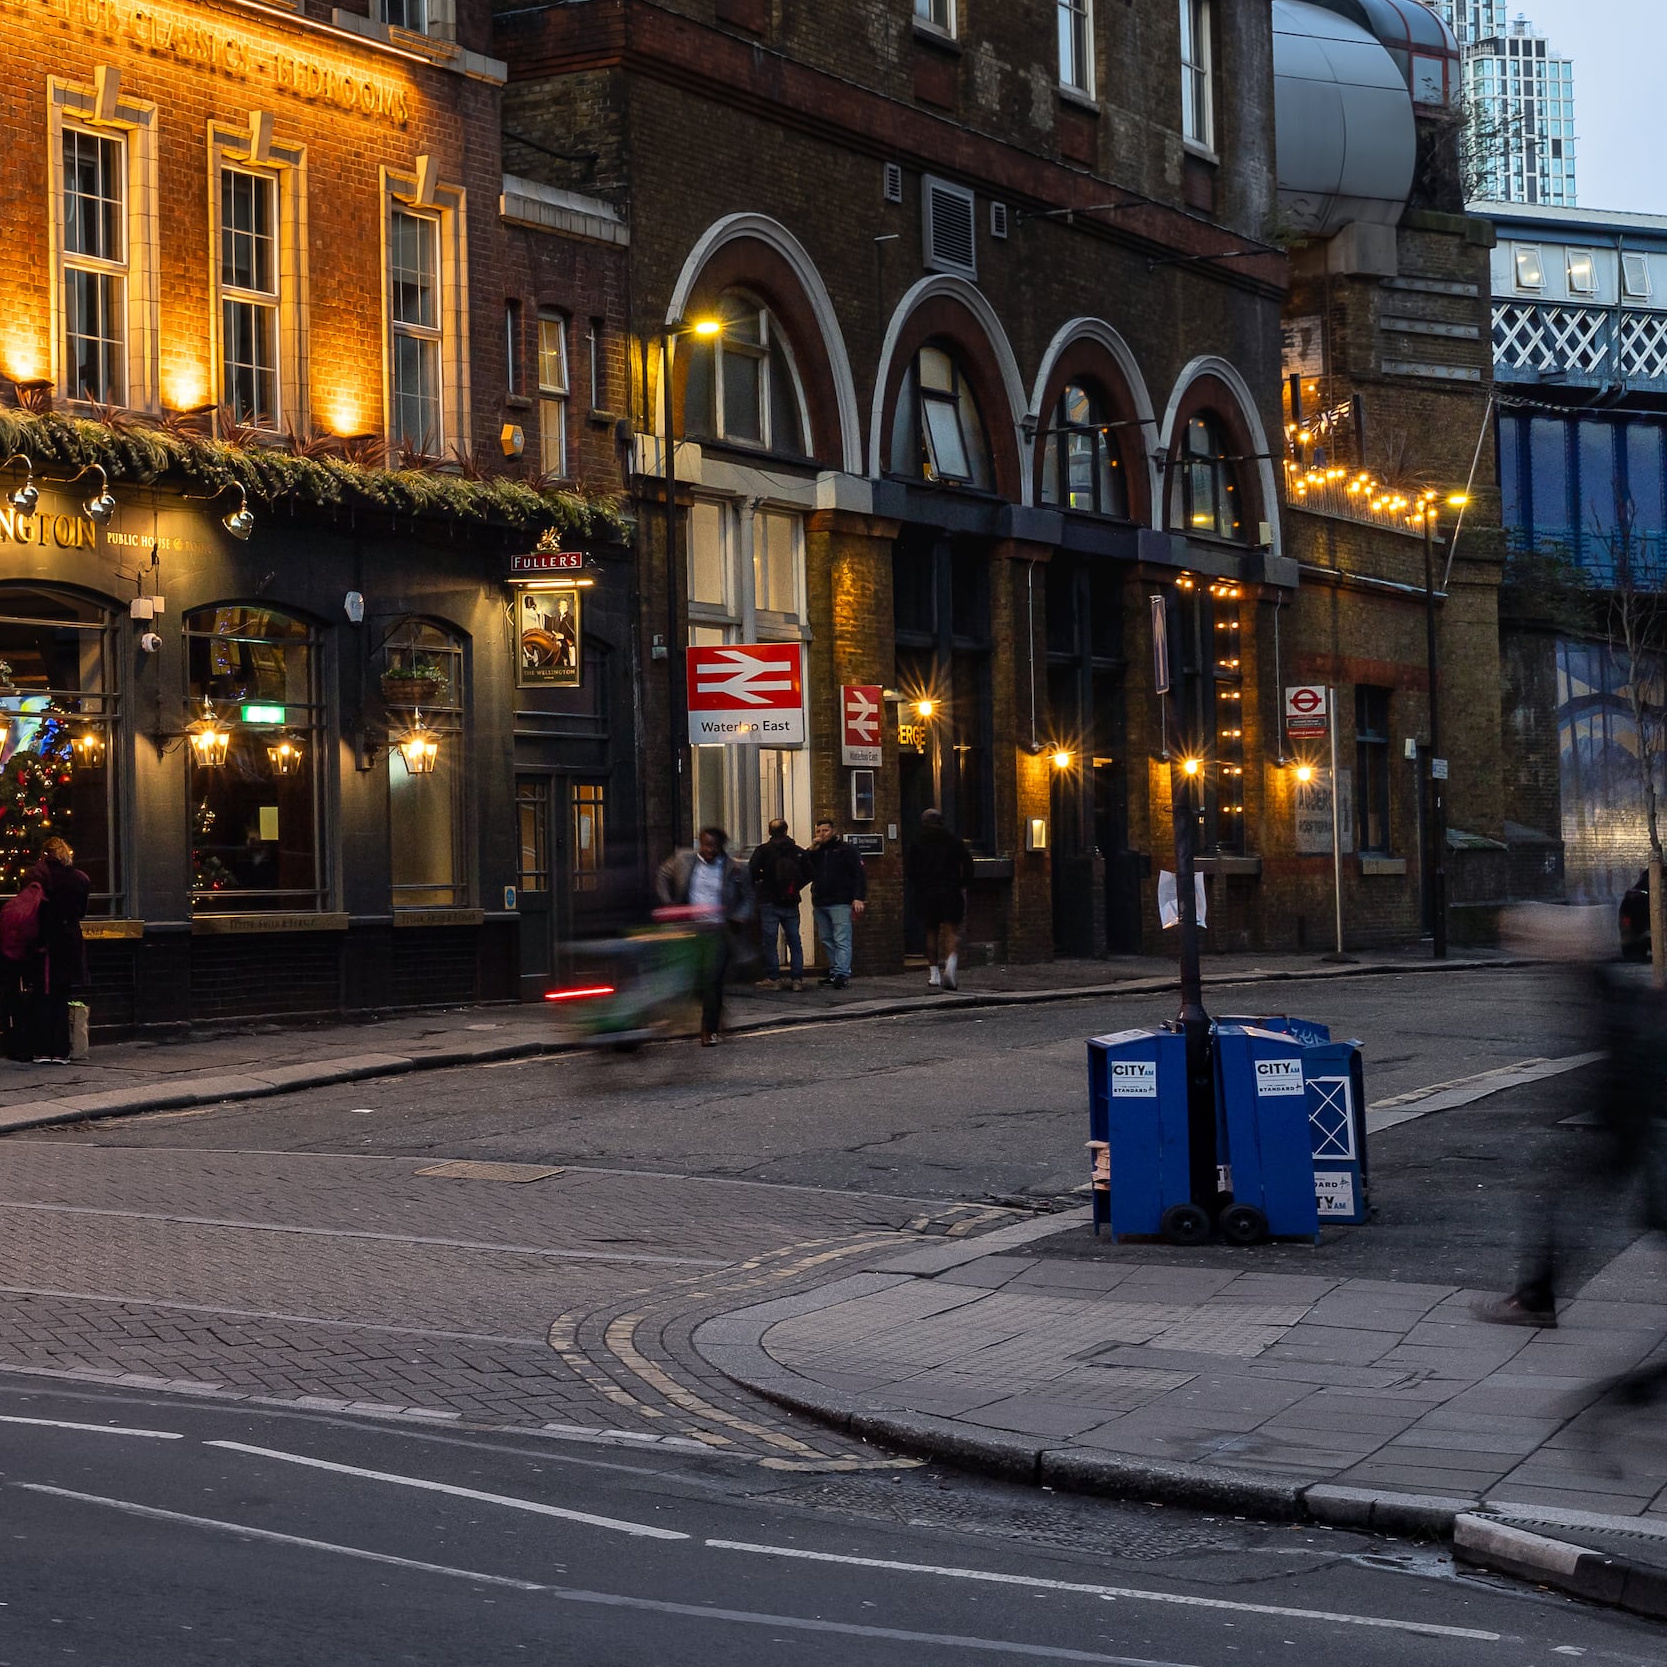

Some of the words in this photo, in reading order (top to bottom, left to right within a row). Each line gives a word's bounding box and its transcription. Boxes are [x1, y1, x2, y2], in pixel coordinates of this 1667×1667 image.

[129, 9, 251, 72] CLASSICS
[276, 52, 409, 120] BEDROOMS
[107, 532, 138, 546] PUBLIC
[141, 536, 170, 550] HOUSE
[514, 555, 577, 569] FULLER'S
[701, 721, 759, 733] Waterloo
[763, 720, 790, 732] East
[1113, 1064, 1145, 1076] CITY
[1257, 1063, 1291, 1075] CITY
